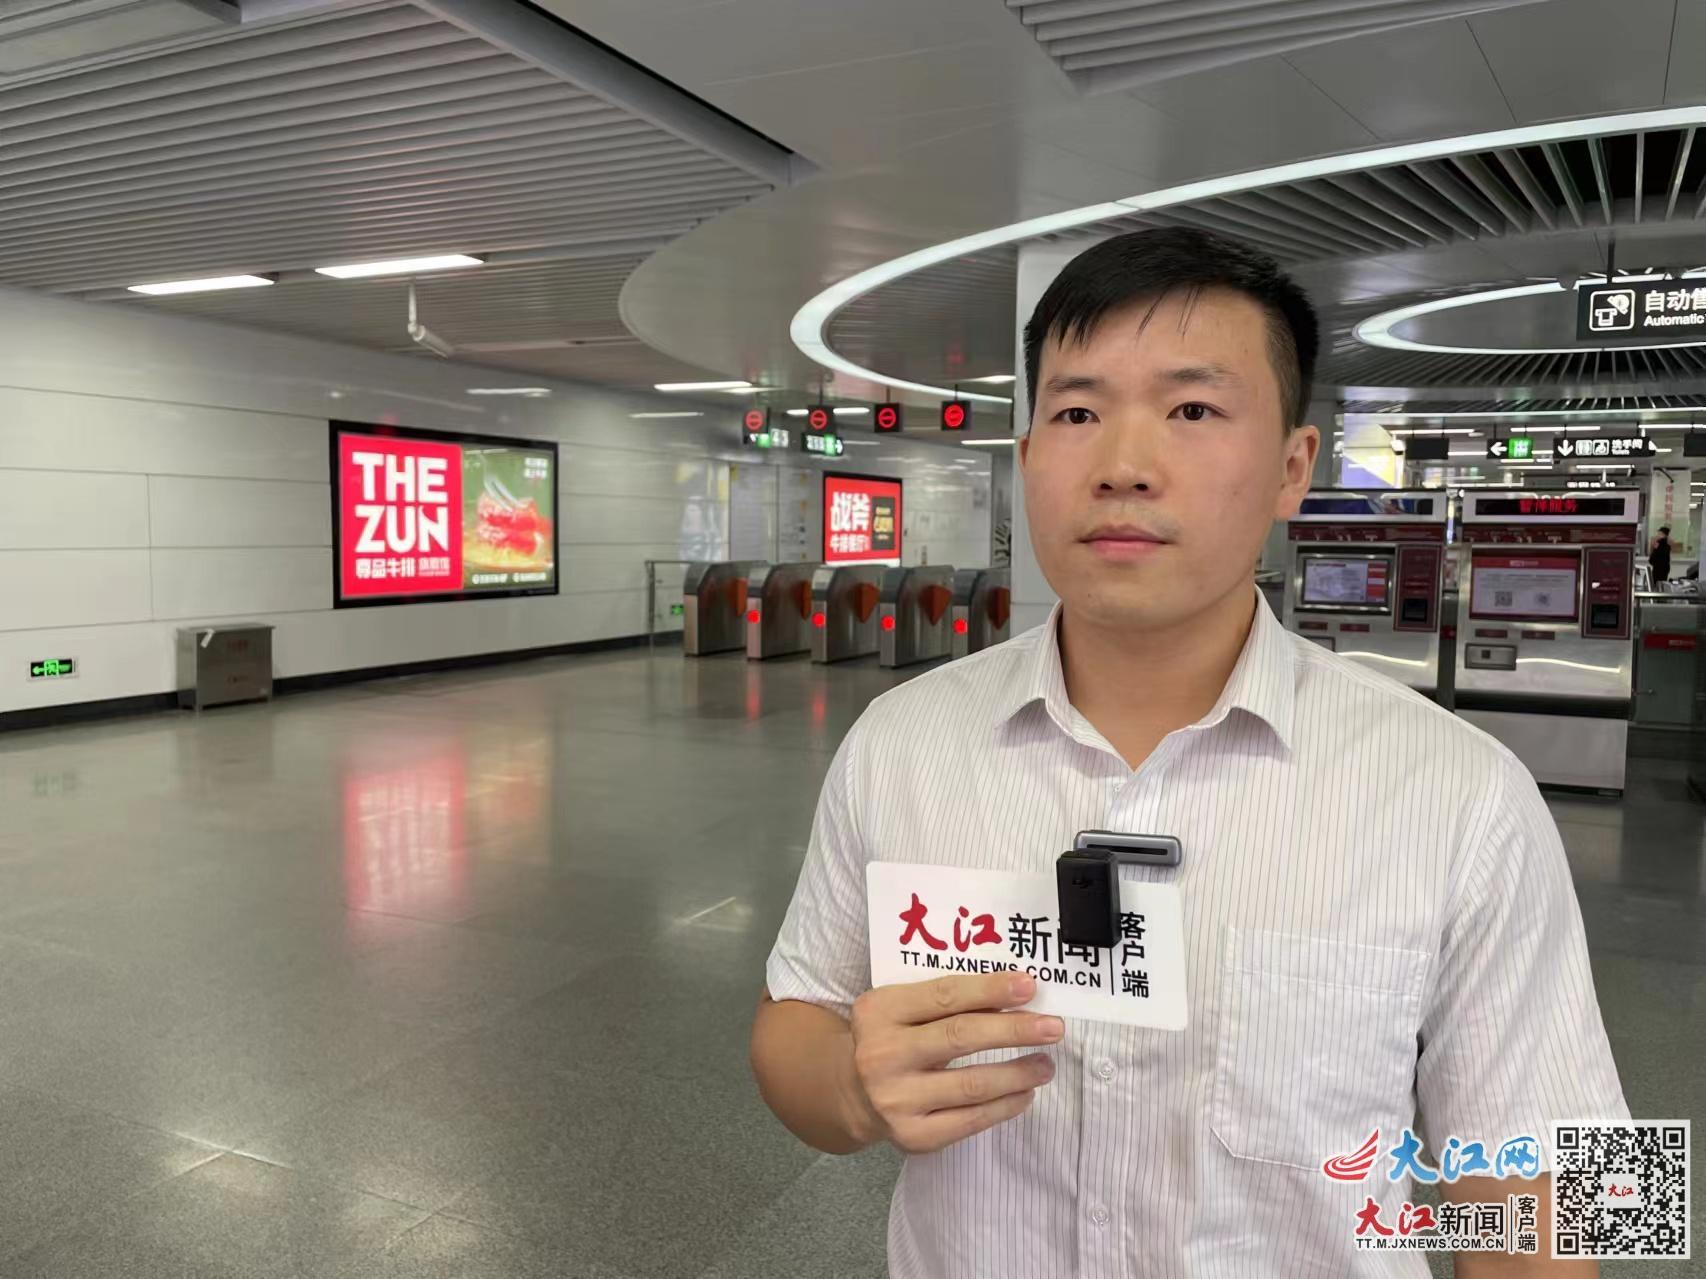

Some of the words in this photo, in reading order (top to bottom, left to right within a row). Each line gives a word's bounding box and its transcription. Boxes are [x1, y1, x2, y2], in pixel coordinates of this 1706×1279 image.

[1644, 314, 1704, 326] Automatic
[1611, 439, 1643, 450] 洗手间
[354, 453, 446, 502] THE
[830, 491, 870, 532] 战斧
[1519, 498, 1577, 513] 暂停服务
[356, 506, 448, 553] ZUN
[355, 557, 416, 579] 尊品牛排
[1120, 911, 1150, 998] 客户端
